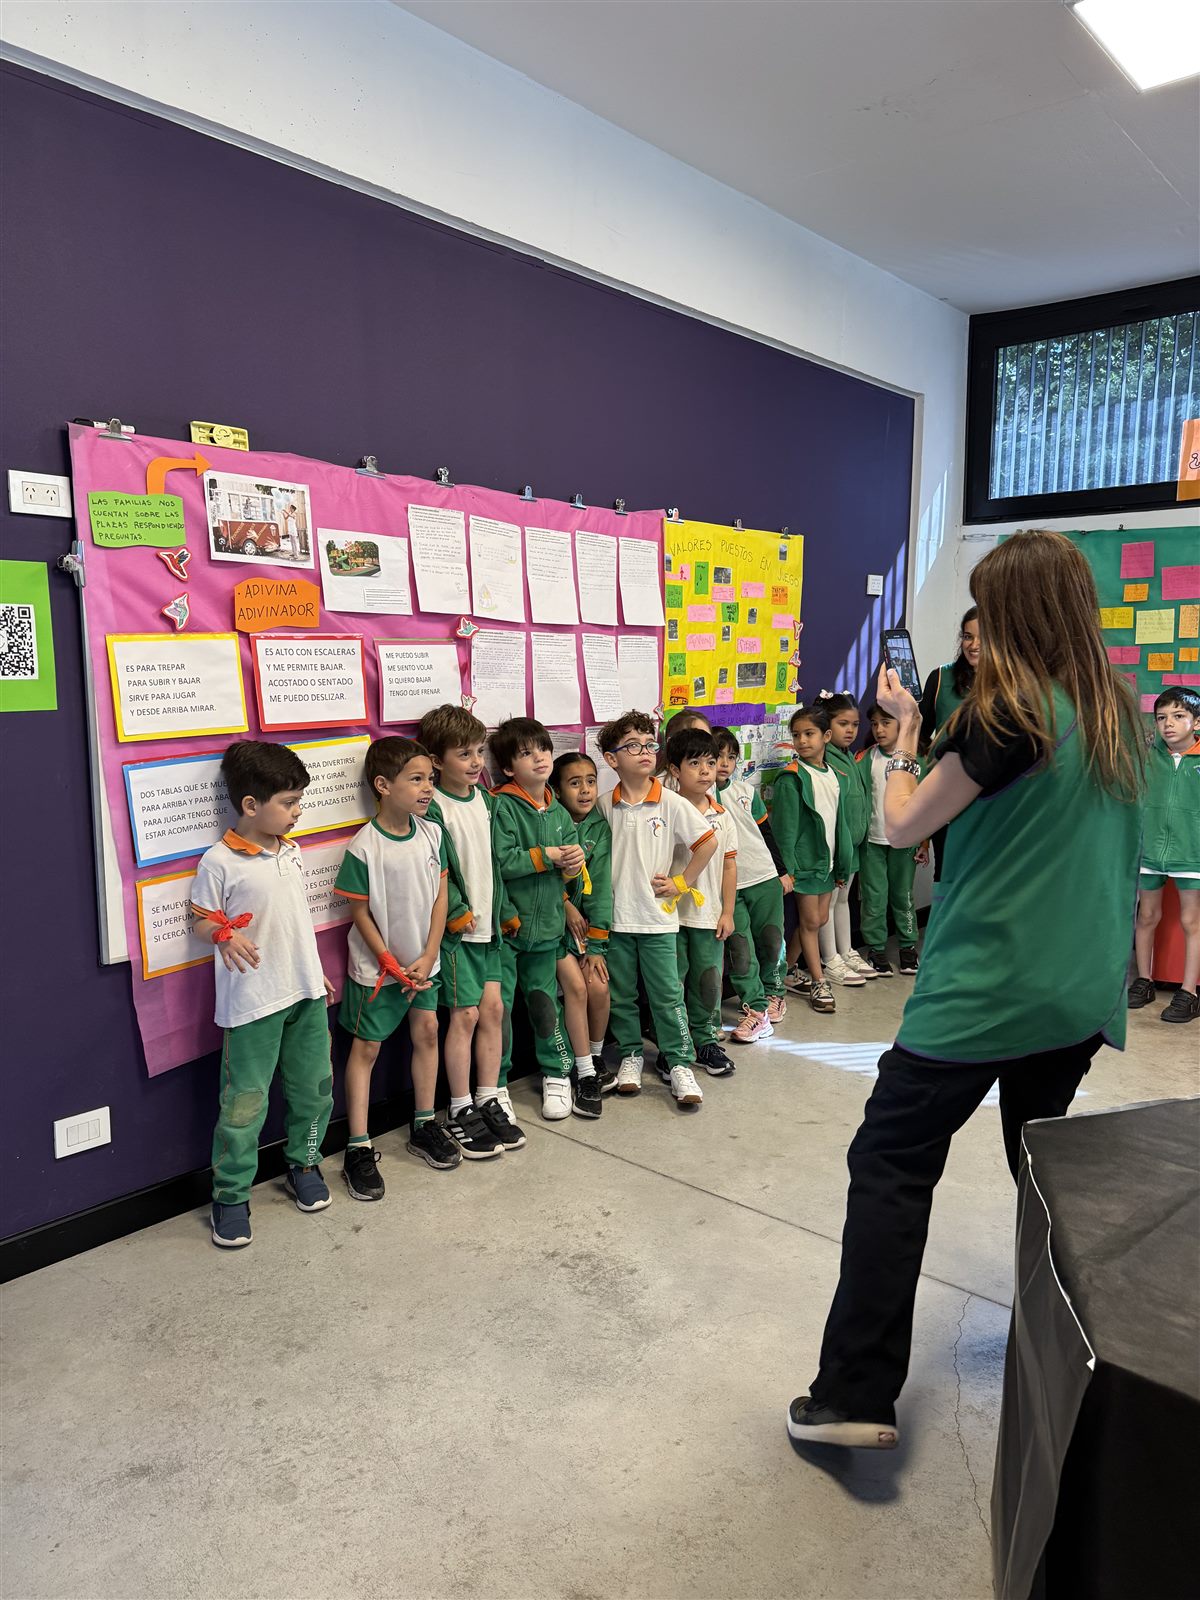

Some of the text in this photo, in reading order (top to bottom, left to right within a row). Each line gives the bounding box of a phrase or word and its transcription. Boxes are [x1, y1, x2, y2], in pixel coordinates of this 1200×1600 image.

[670, 539, 712, 556] VALORES
[721, 540, 754, 563] PUESTOS
[760, 556, 771, 571] EN
[245, 584, 297, 598] ADIVINA
[238, 602, 314, 620] ADIVINADOR
[265, 648, 274, 656] ES
[149, 678, 170, 686] SUBIR
[178, 677, 201, 685] BAJAR
[268, 679, 308, 687] ACOSTADO
[318, 678, 353, 686] SENTADO
[129, 694, 149, 702] SIRVE
[284, 694, 310, 702] PUEDO
[311, 693, 346, 701] DESLIZAR.
[136, 708, 160, 716] DESDE
[162, 706, 189, 714] ARRIBA
[190, 704, 216, 713] MIRAR.
[322, 757, 356, 767] DIVERTIRSE
[140, 790, 155, 799] DOS
[156, 786, 182, 796] TABLAS
[184, 784, 199, 792] QUE
[210, 780, 228, 789] MUE
[305, 786, 333, 796] VUELTAS
[142, 804, 160, 813] PARA
[162, 799, 187, 810] ARRIBA
[194, 796, 213, 804] PARA
[317, 798, 340, 807] PLAZAS
[143, 807, 228, 827] PARA JUGAR TENGO QUE
[145, 830, 166, 840] ESTAR
[152, 906, 160, 914] SE
[152, 912, 194, 928] SU PERFUM
[162, 929, 186, 940] CERCA
